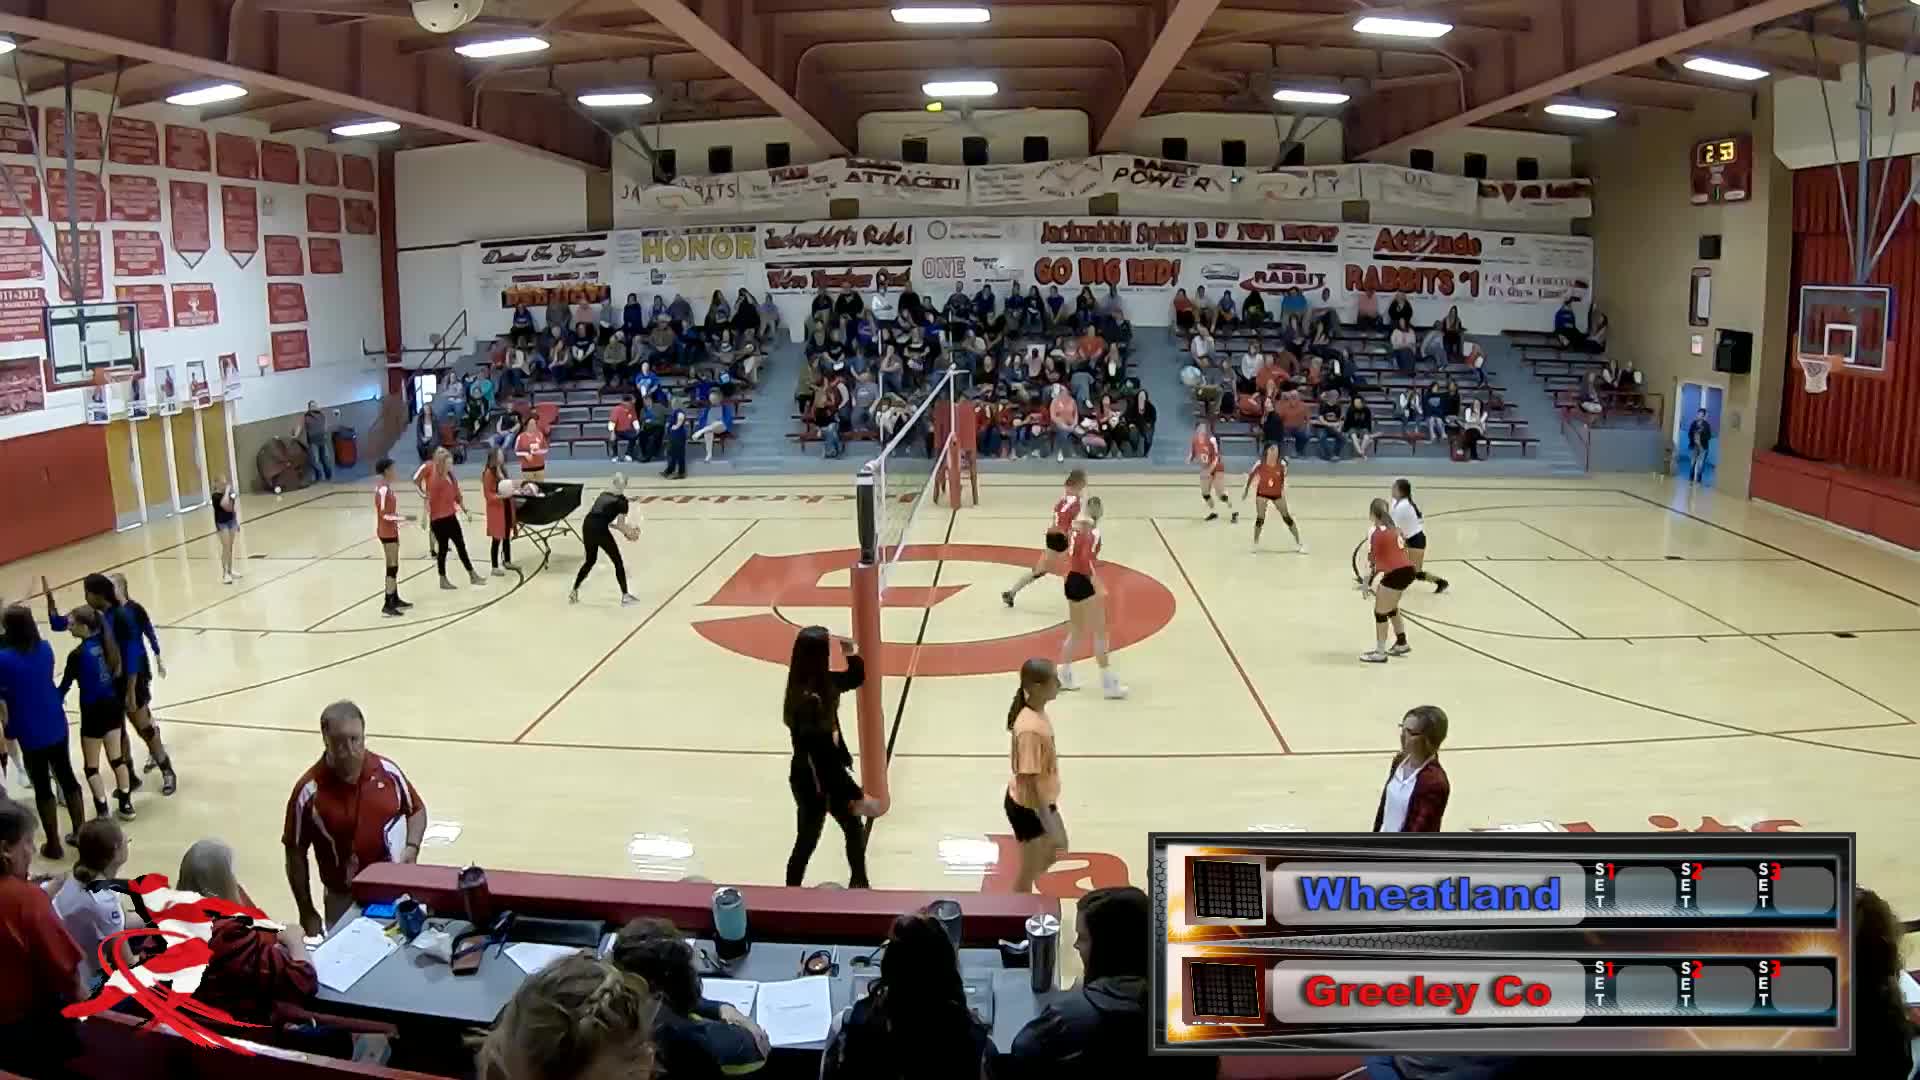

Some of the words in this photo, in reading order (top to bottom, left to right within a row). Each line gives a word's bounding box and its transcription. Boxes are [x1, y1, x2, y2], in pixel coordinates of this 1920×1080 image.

[642, 234, 756, 264] HONOR
[922, 256, 966, 280] ONE
[1034, 256, 1073, 286] GO
[1078, 257, 1121, 286] BIG
[1254, 270, 1326, 286] RABBIT
[1345, 263, 1455, 297] RABBITS
